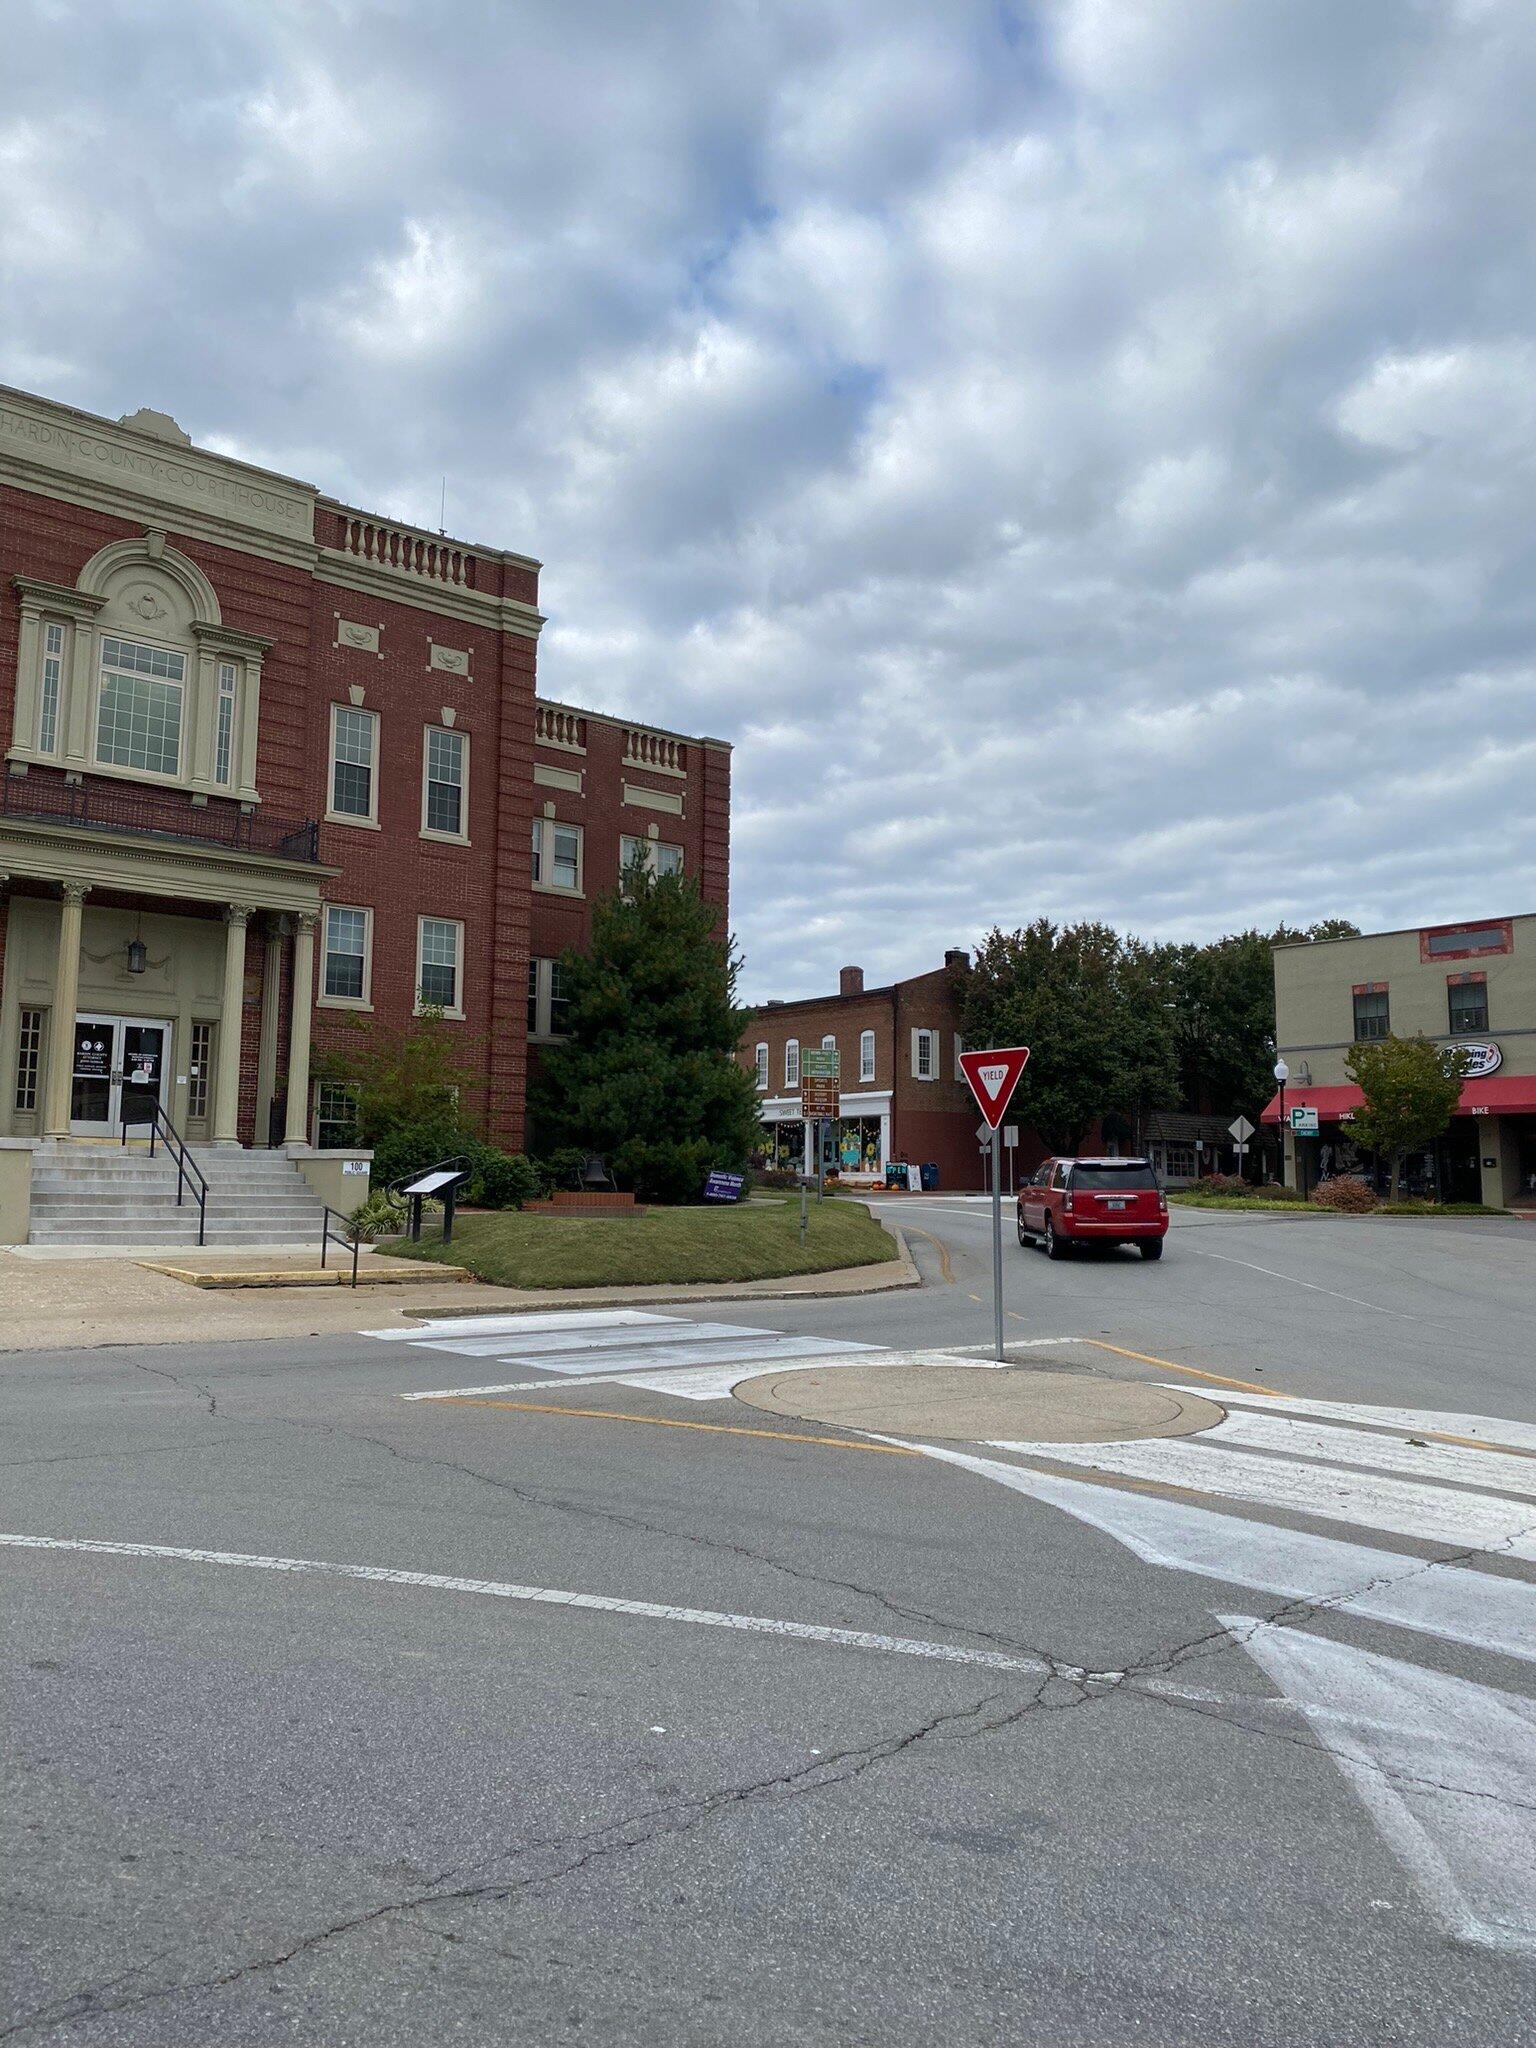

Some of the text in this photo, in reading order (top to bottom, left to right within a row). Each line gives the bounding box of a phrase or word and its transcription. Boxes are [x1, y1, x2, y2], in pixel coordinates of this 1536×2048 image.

[0, 414, 297, 519] HARDIN COUNTY COURT HOUSE
[982, 1070, 1004, 1081] YIELD
[1471, 1107, 1489, 1115] BIKE
[350, 1162, 363, 1171] 100
[886, 1166, 907, 1174] OPEN
